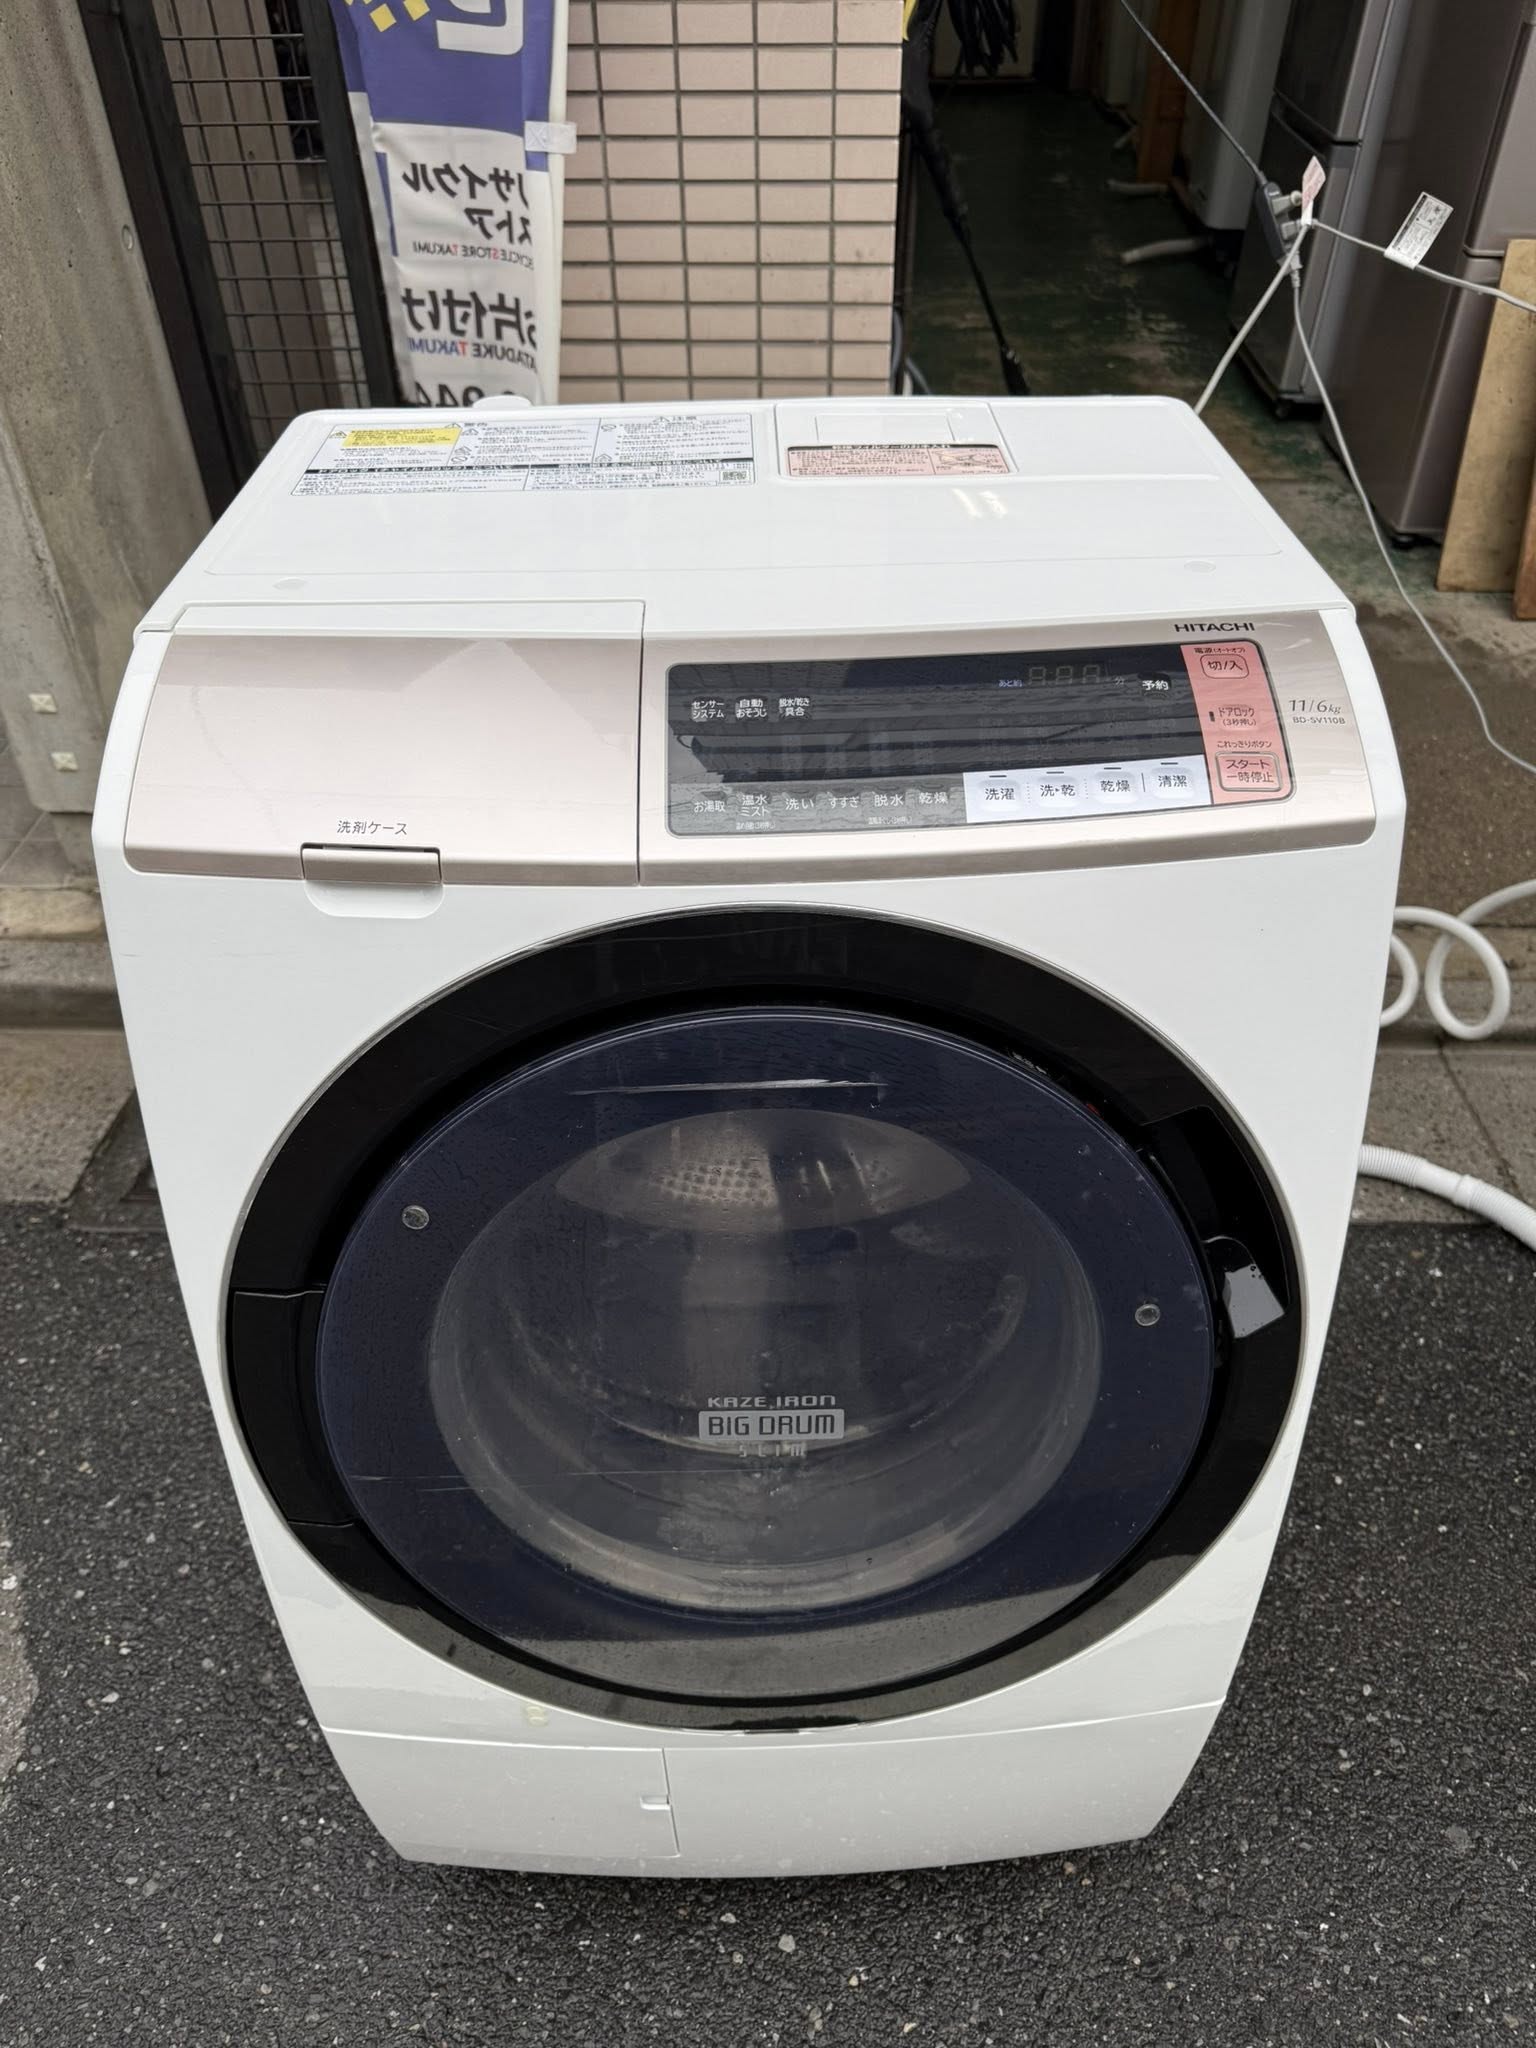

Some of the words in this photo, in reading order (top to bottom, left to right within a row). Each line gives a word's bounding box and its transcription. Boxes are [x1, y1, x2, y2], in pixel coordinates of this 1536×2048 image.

[1174, 622, 1255, 633] HITACHI
[1208, 660, 1243, 671] 切/入
[1142, 680, 1169, 691] 予約
[691, 700, 725, 710] センサー
[739, 699, 763, 708] 自動
[692, 709, 725, 719] システム
[736, 708, 767, 718] おそうじ
[1218, 706, 1255, 718] ドアロック
[1293, 716, 1346, 725] BD-SV110B
[1226, 759, 1270, 769] スタート
[1158, 774, 1188, 788] 清潔
[1226, 772, 1274, 783] 一時停止
[1100, 779, 1131, 793] 乾燥
[742, 794, 768, 806] 温水
[918, 791, 948, 804] 乾燥
[985, 787, 1015, 801] 洗濯
[694, 800, 726, 812] お湯取
[785, 798, 814, 811] 洗い
[829, 796, 860, 809] すすぎ
[874, 794, 904, 807] 脱水
[739, 805, 770, 817] ミスト
[336, 820, 408, 835] 洗剤ケース
[707, 1396, 767, 1408] KAZE
[776, 1395, 836, 1407] IRON
[708, 1416, 750, 1436] BIG
[758, 1415, 835, 1435] DRUM
